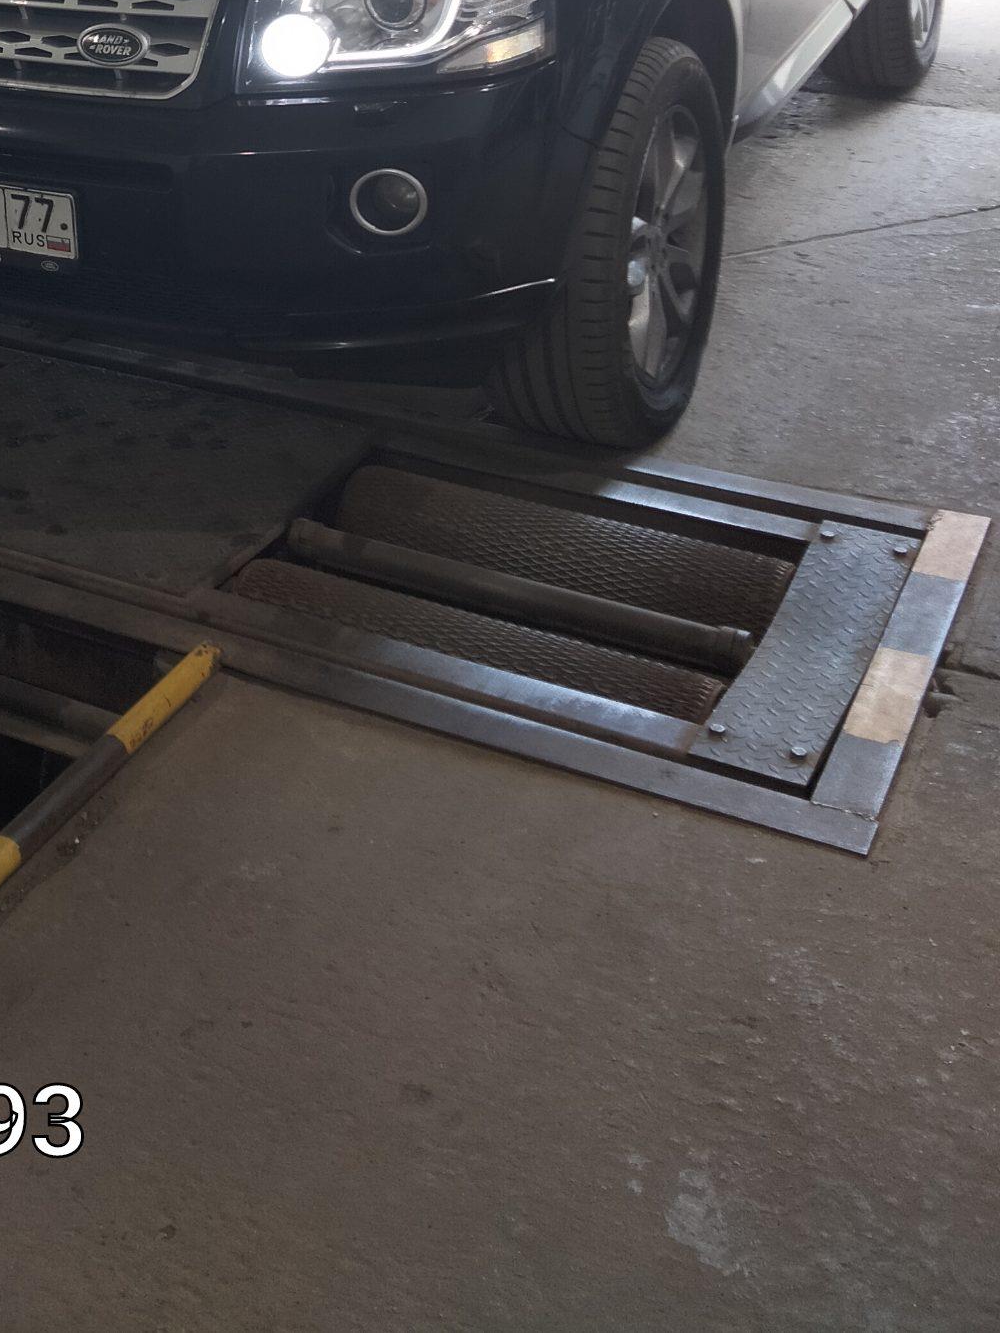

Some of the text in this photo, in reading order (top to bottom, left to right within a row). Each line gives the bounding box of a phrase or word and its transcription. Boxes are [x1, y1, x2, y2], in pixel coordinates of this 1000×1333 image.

[94, 44, 132, 56] ROVER
[11, 193, 55, 234] 77
[13, 231, 46, 248] RUS
